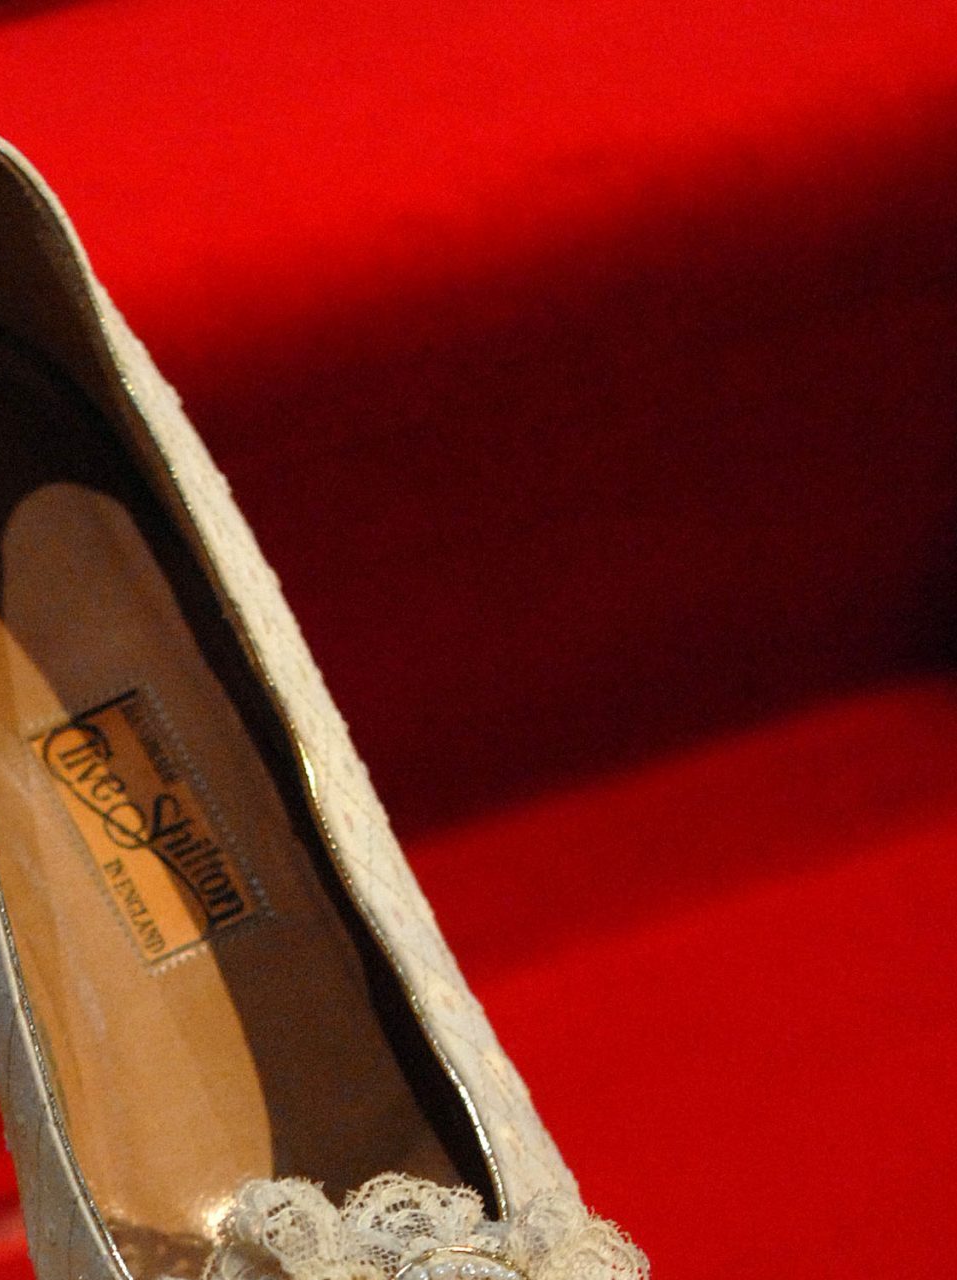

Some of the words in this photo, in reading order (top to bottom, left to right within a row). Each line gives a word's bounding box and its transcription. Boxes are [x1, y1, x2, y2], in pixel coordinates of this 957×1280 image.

[103, 856, 124, 882] IN
[105, 794, 245, 929] Shilton
[113, 876, 166, 954] ENGLAND
